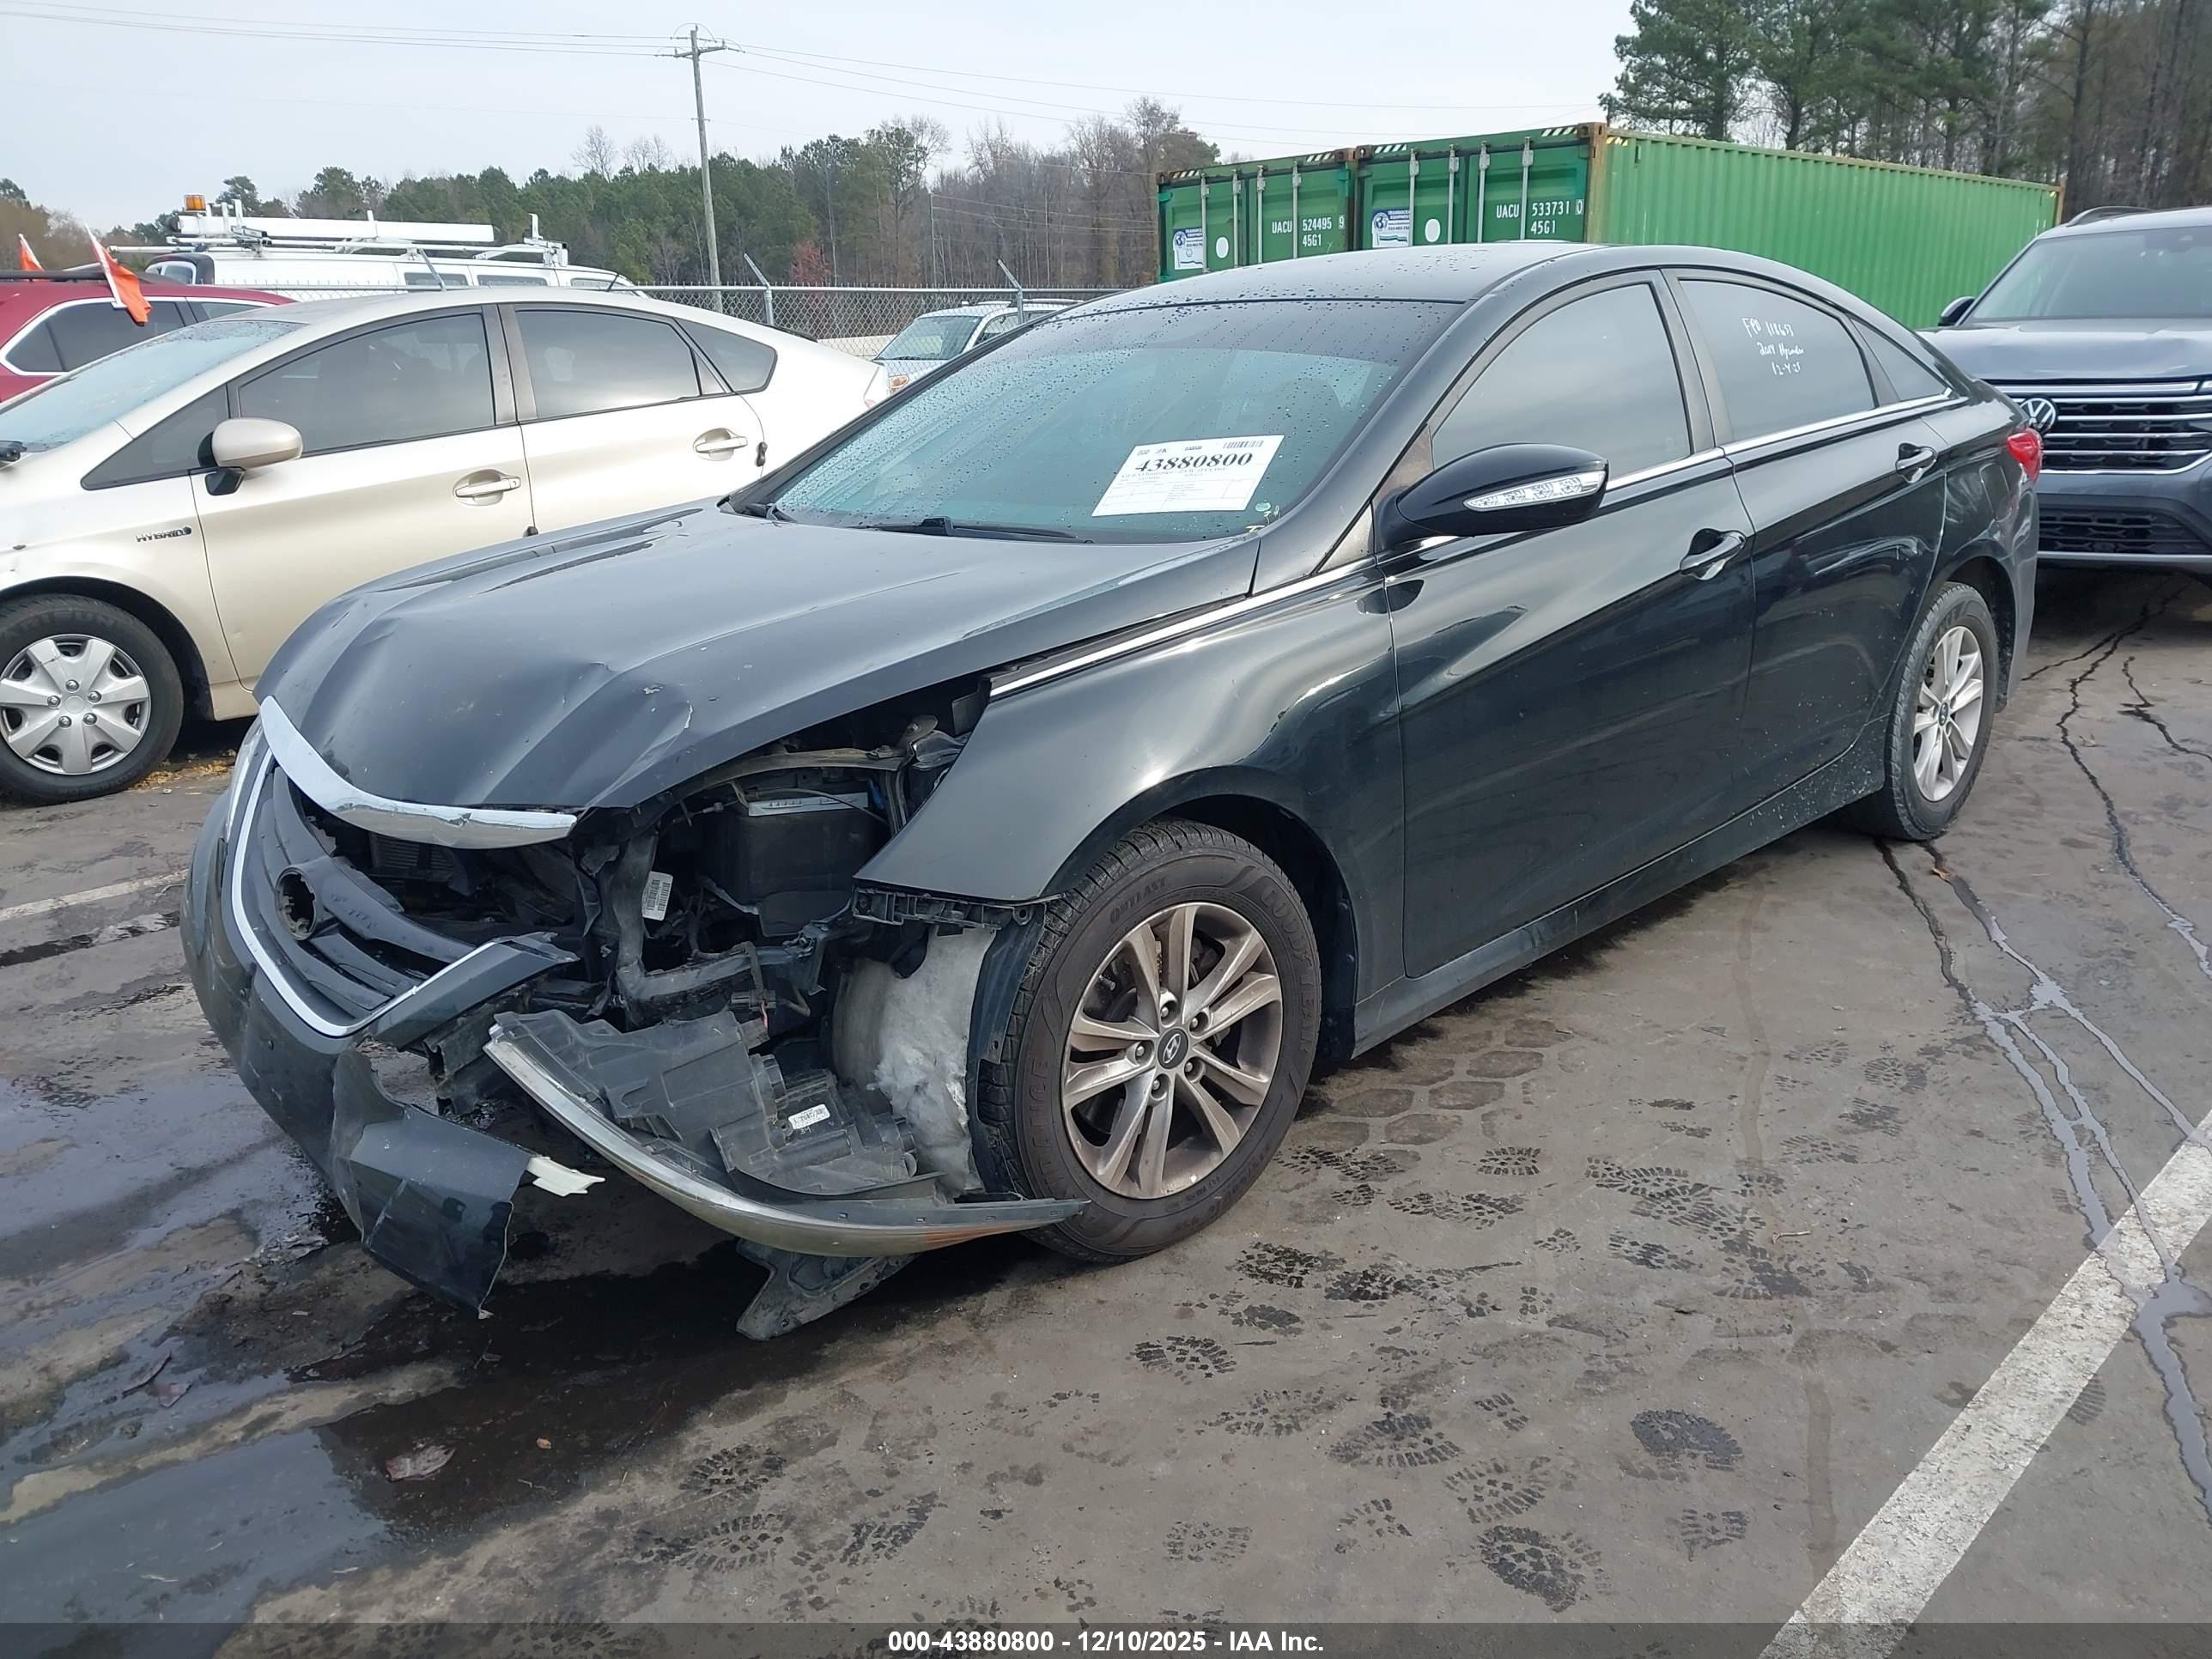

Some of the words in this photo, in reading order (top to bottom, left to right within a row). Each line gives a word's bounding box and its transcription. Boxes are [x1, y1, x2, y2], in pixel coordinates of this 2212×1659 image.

[1497, 204, 1520, 218] UACU
[1532, 201, 1570, 216] 533731
[1577, 200, 1584, 214] 0
[1272, 221, 1292, 234] UACU
[1303, 217, 1332, 231] 524495
[1340, 216, 1345, 228] 9
[1531, 220, 1556, 234] 45G1
[1303, 234, 1322, 246] 45G1
[1135, 453, 1254, 472] 43880800
[137, 529, 185, 542] HYBRID
